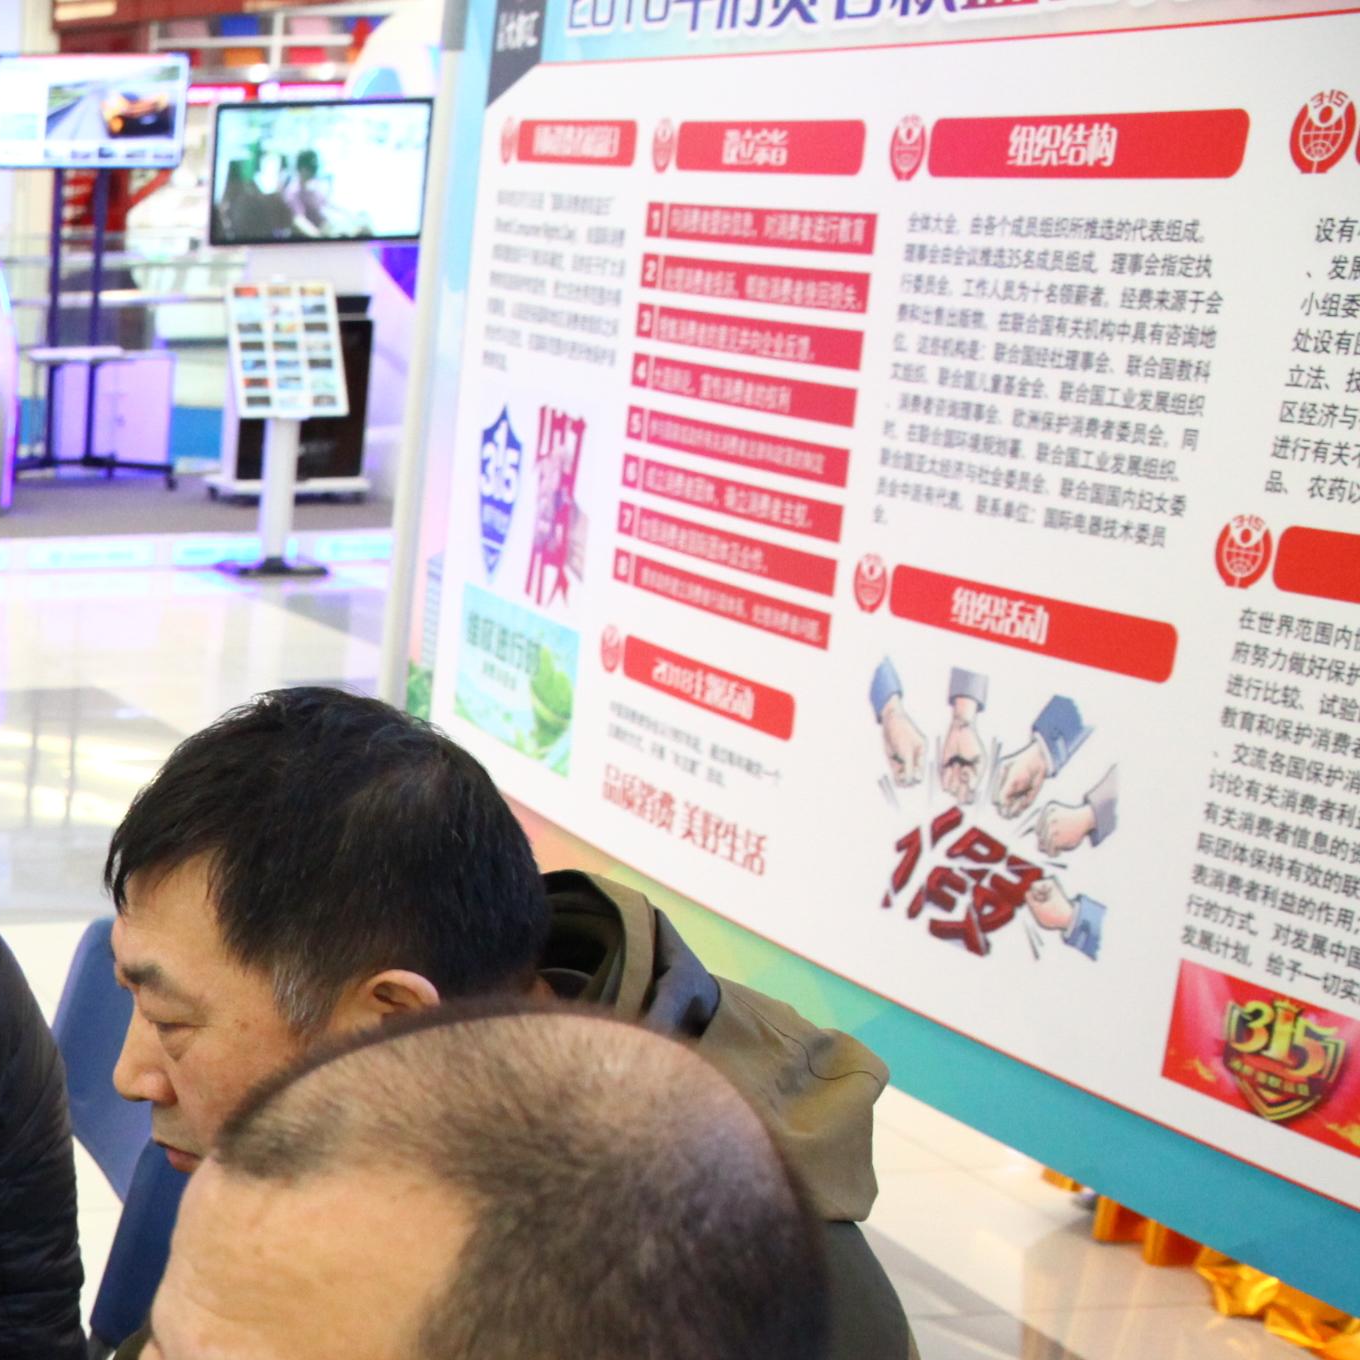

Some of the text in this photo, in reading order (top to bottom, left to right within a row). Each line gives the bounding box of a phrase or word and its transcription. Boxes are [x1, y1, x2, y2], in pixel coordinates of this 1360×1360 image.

[722, 129, 788, 166] 设立宗旨
[1007, 123, 1118, 167] 组织结构
[1315, 217, 1360, 243] 设有
[1300, 291, 1360, 318] 小组委
[1280, 400, 1360, 430] 区经济与
[951, 587, 1049, 645] 组织活动
[681, 800, 768, 877] 美好生活
[1231, 998, 1338, 1077] 315
